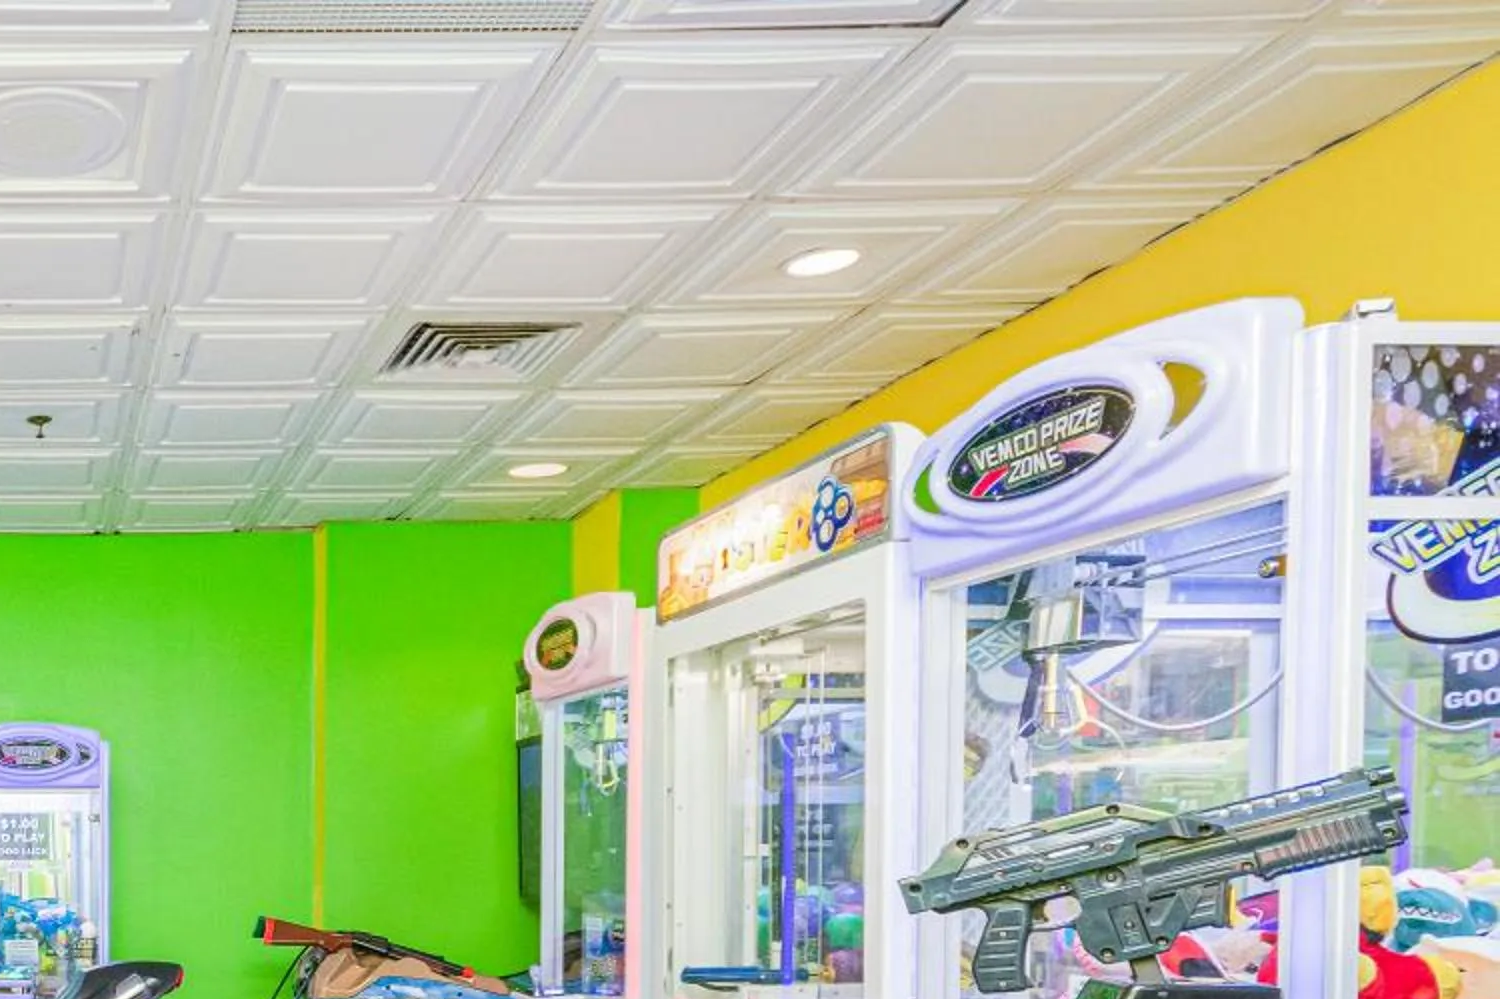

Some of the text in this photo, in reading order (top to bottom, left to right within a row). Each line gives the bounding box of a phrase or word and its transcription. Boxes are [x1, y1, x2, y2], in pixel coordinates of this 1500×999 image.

[972, 400, 1104, 471] VEMCO PRIZE
[1007, 446, 1064, 484] ZONE
[1451, 648, 1499, 674] TO
